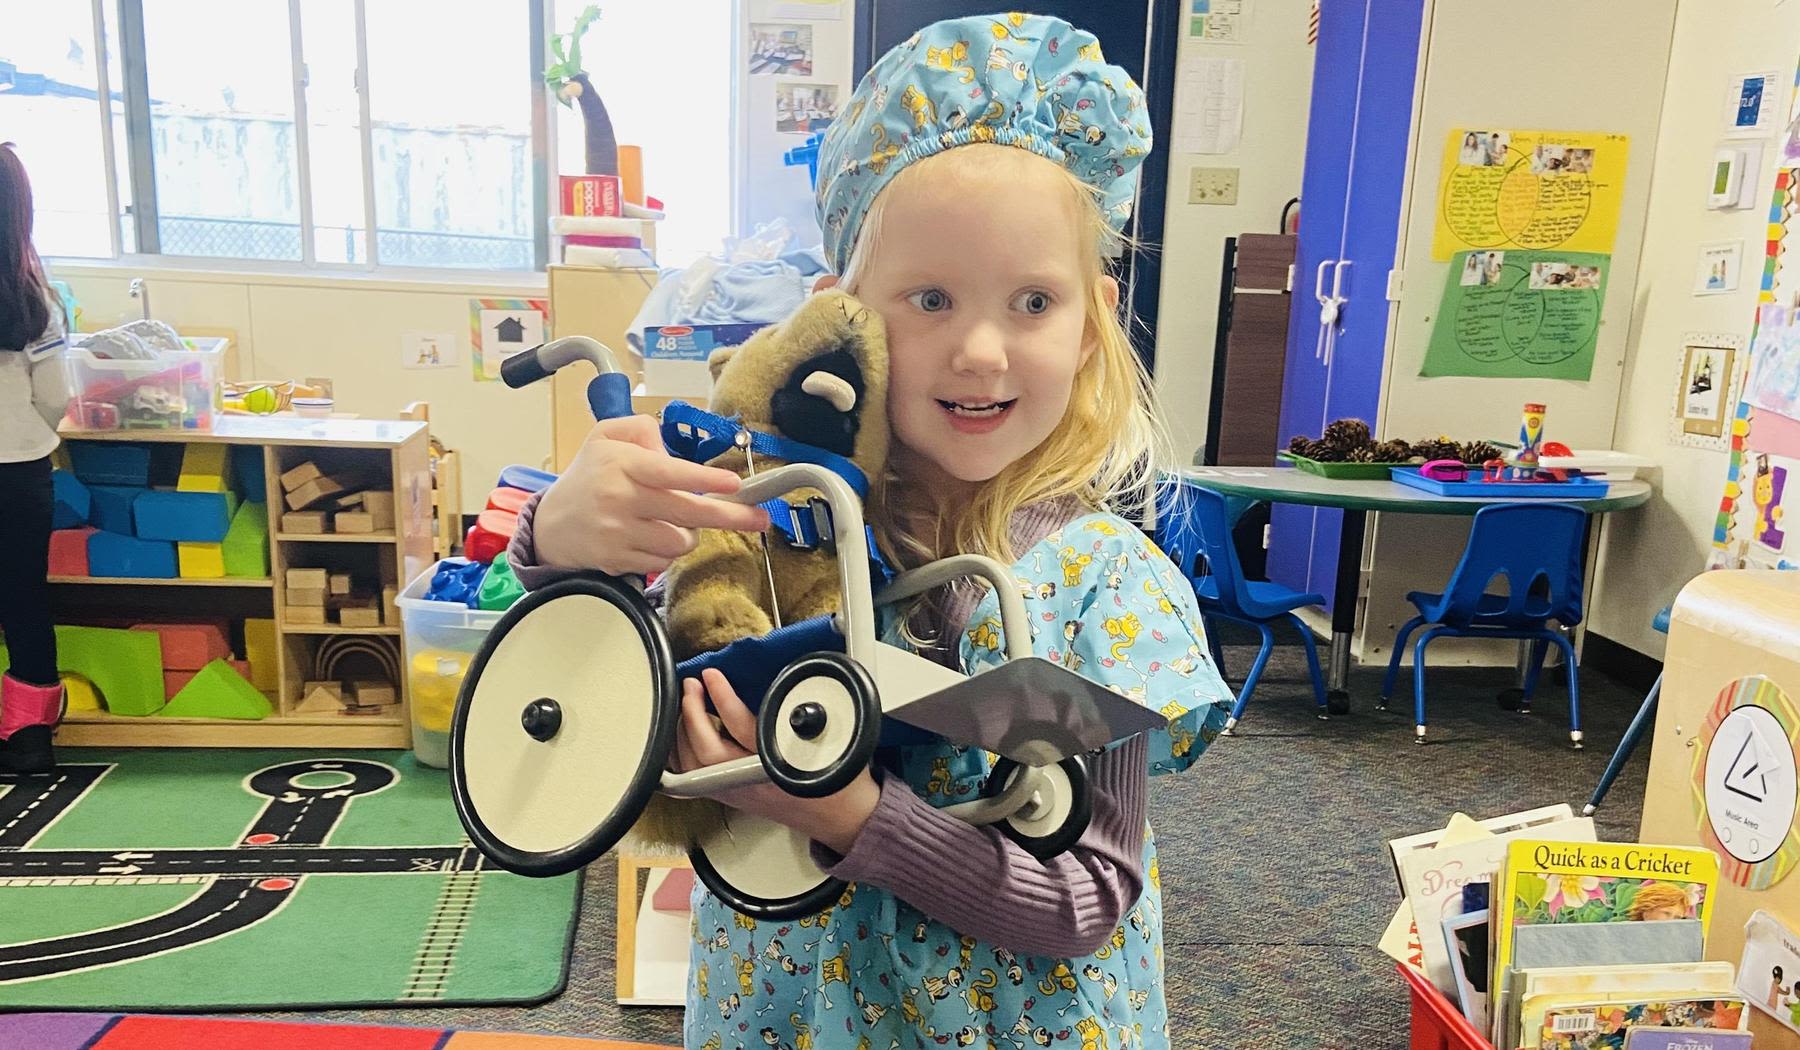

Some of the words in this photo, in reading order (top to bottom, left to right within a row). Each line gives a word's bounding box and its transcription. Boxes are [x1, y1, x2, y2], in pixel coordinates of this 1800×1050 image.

[655, 336, 678, 351] 48
[1725, 808, 1742, 823] Music
[1743, 817, 1759, 830] Area
[1534, 845, 1586, 870] Quick
[1591, 854, 1607, 869] as
[1611, 856, 1620, 870] a
[1624, 850, 1693, 875] Cricket
